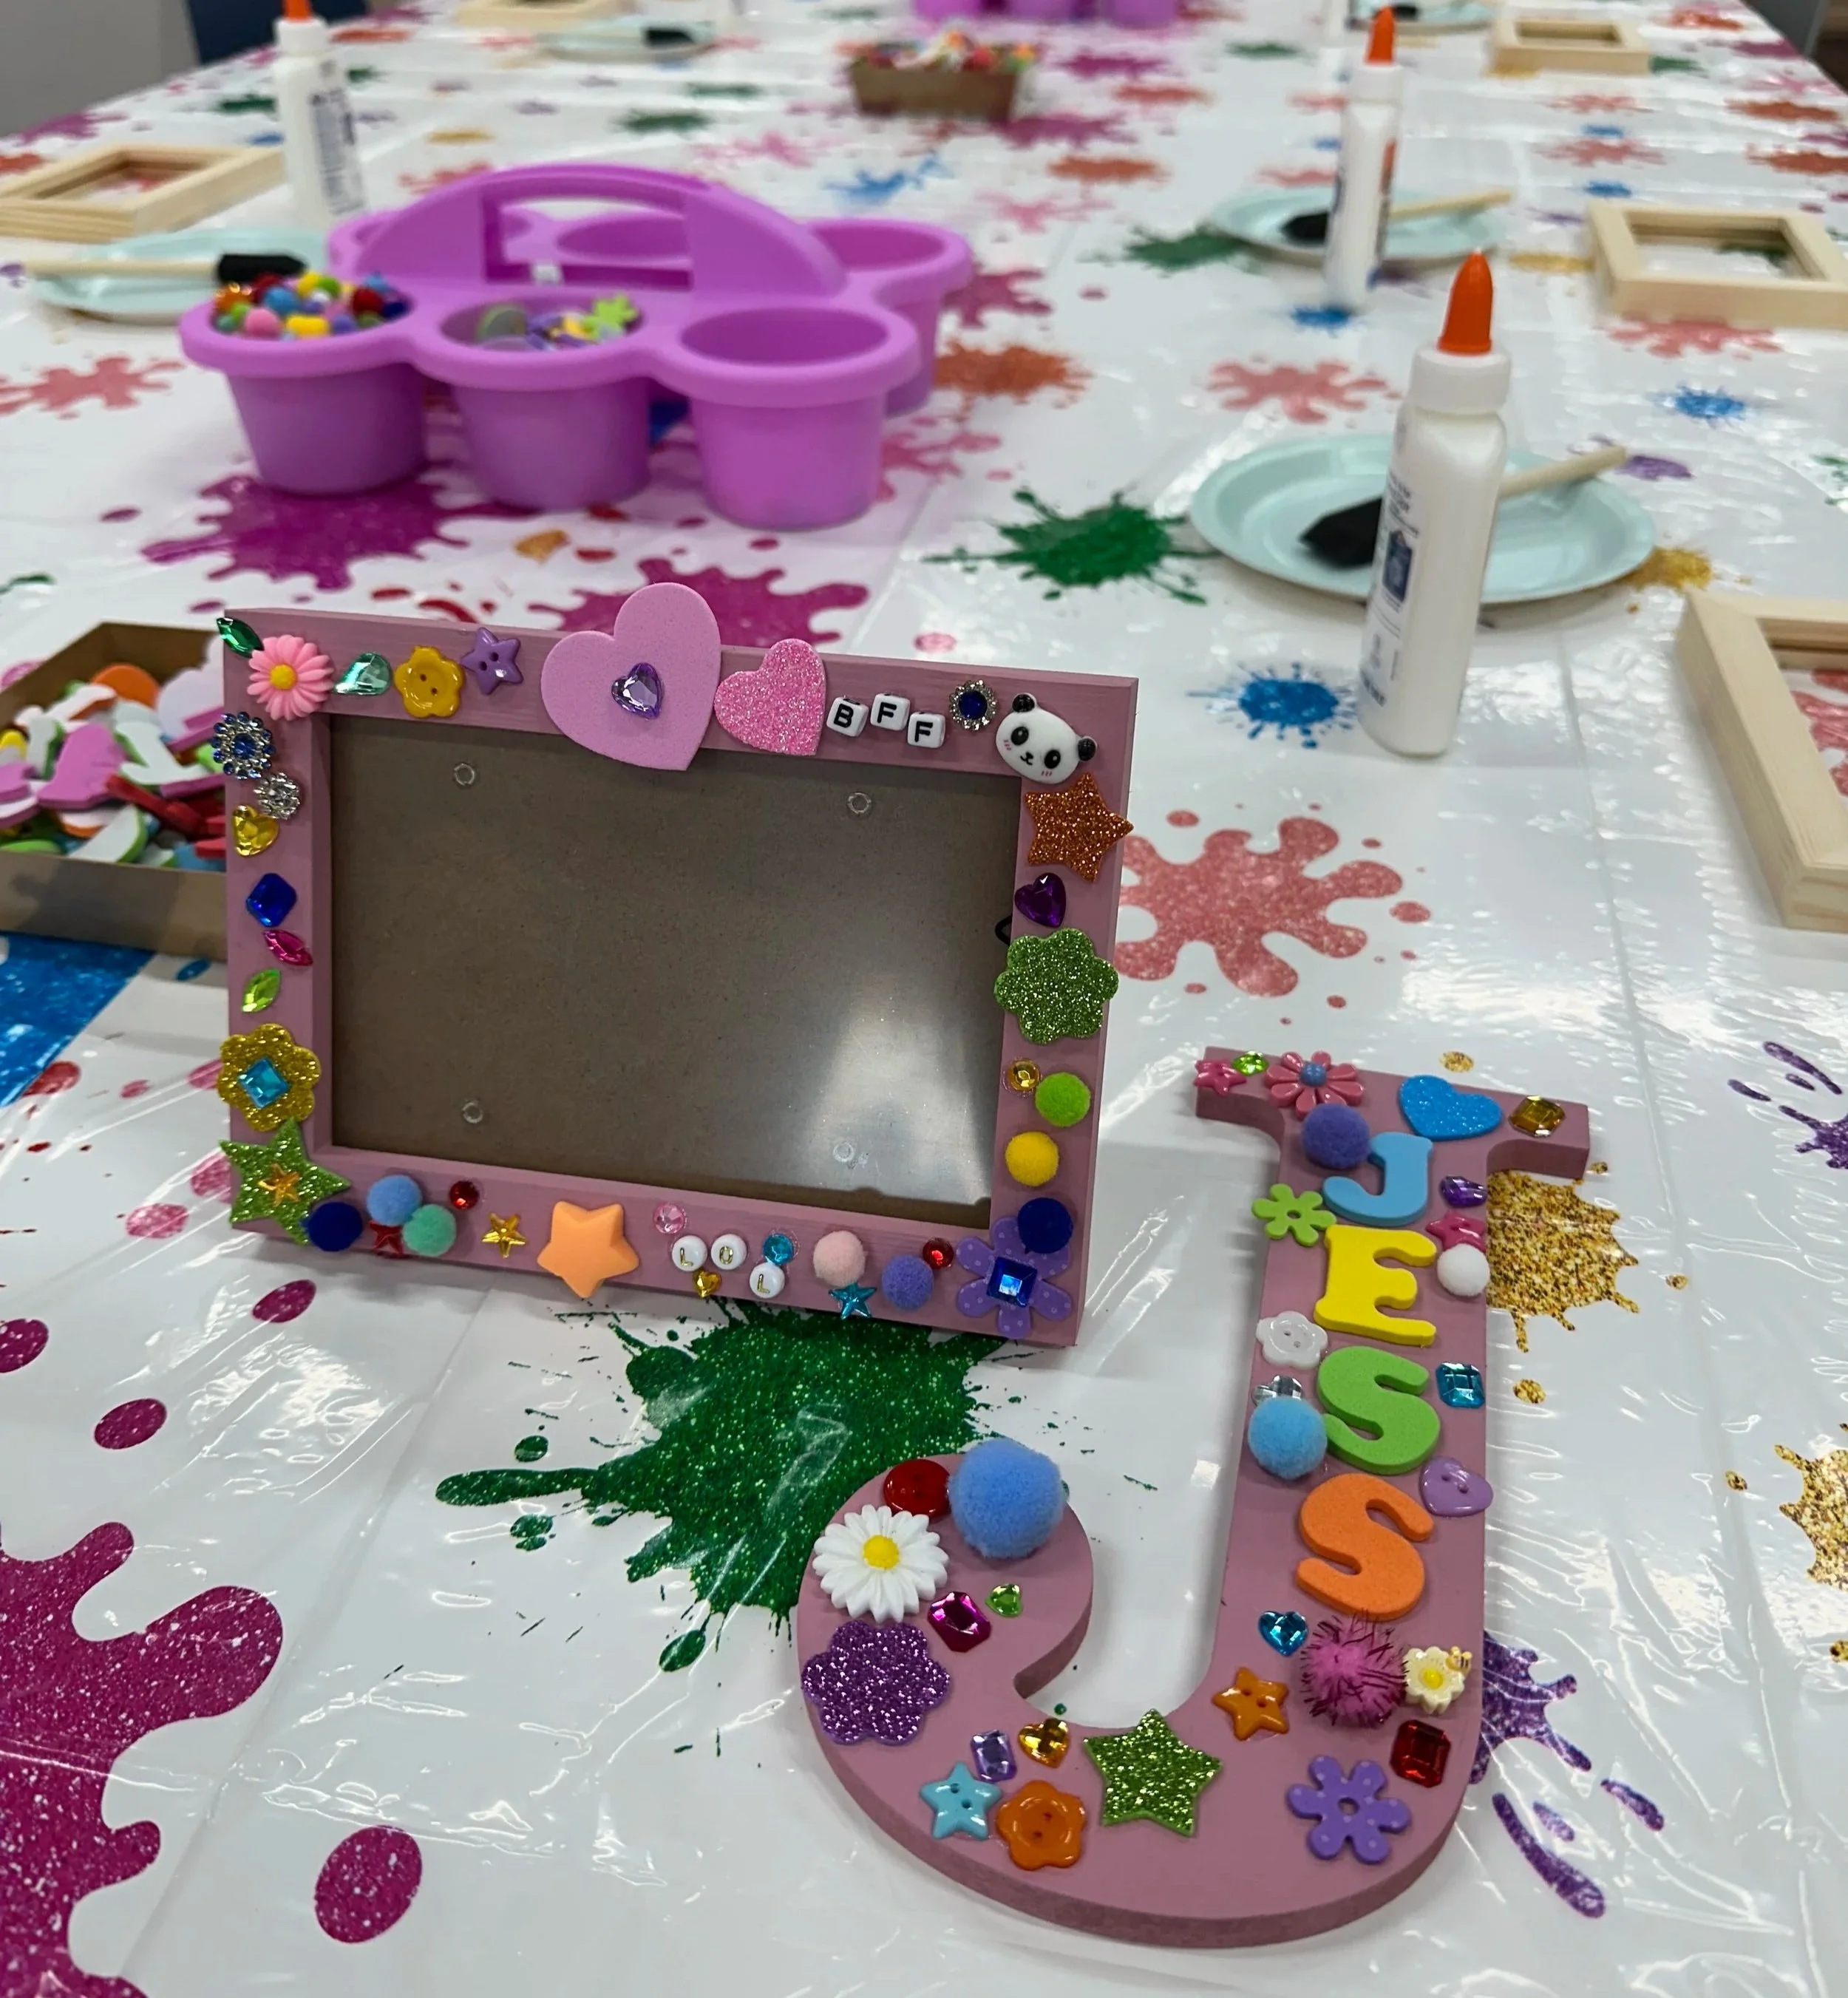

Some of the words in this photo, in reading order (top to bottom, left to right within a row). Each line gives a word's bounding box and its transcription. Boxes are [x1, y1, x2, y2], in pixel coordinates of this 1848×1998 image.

[832, 701, 934, 743] BFF
[679, 1246, 770, 1294] LOL
[1295, 1131, 1441, 1622] JESS
